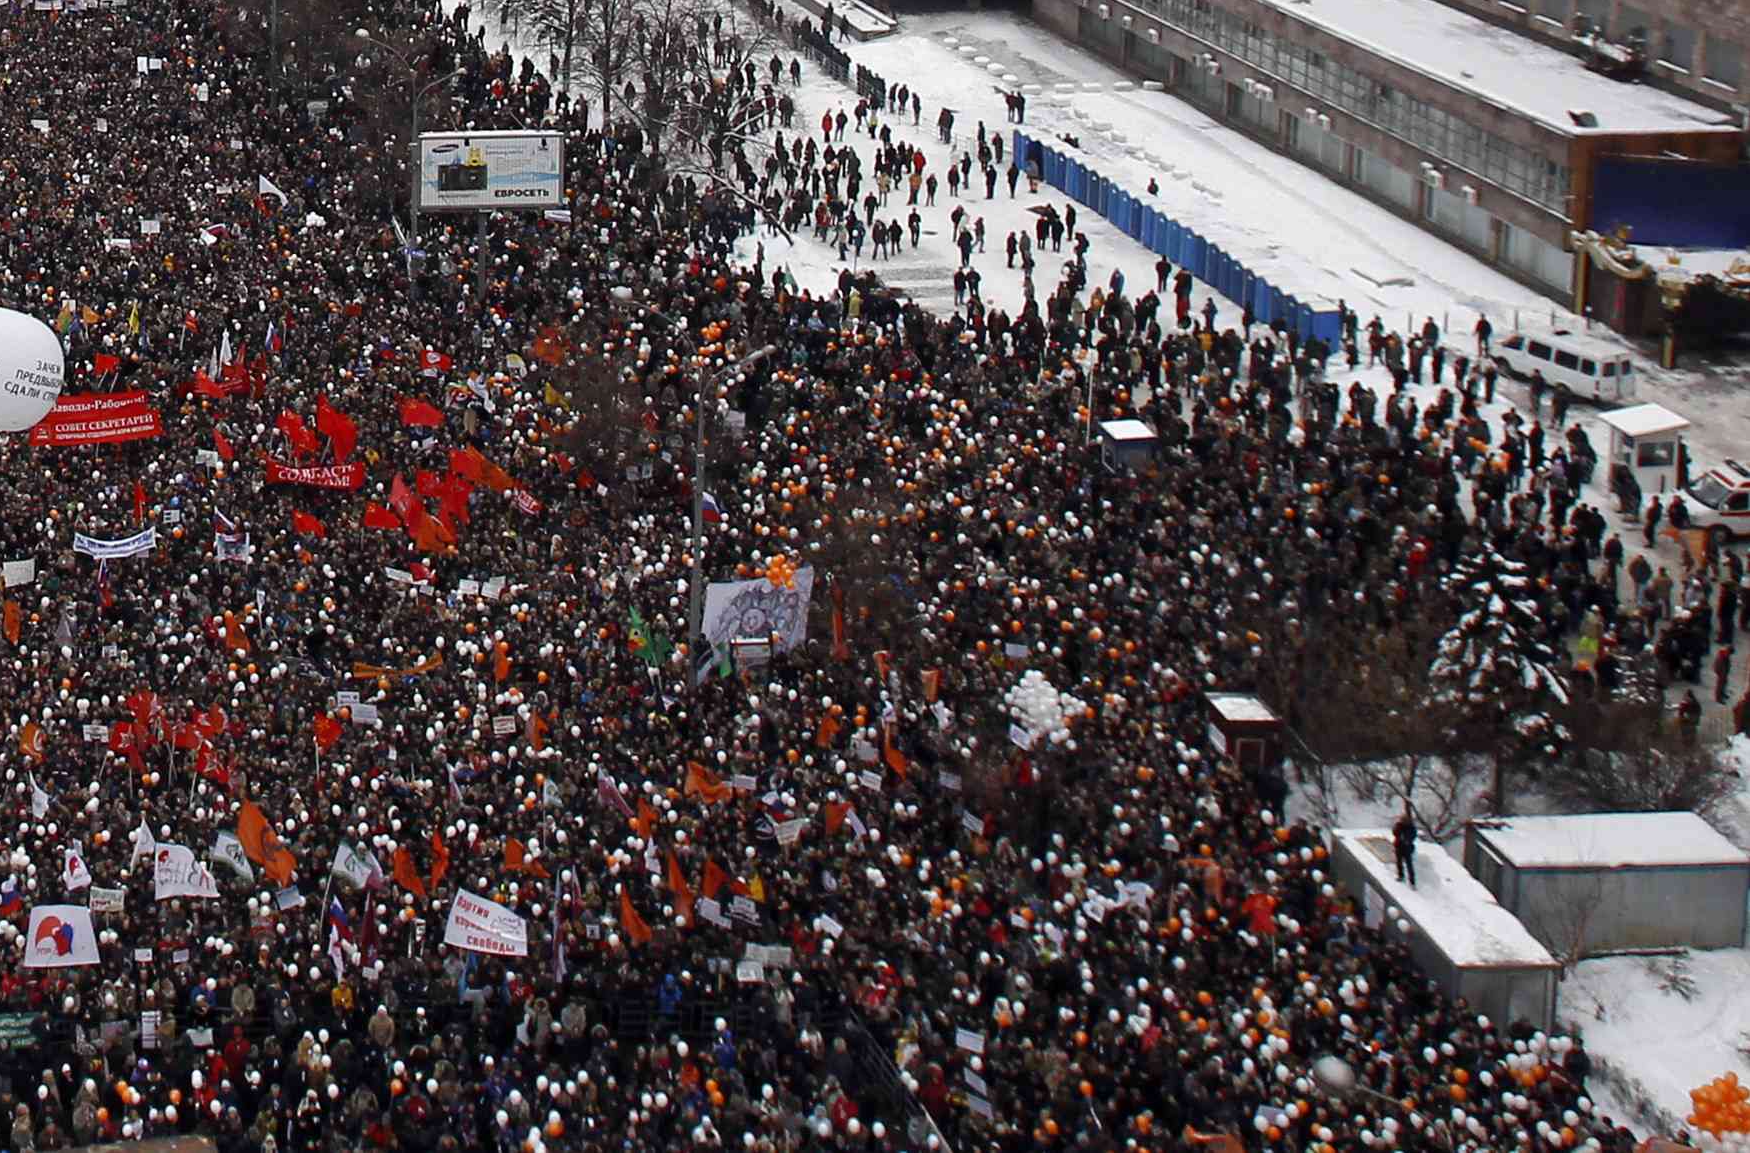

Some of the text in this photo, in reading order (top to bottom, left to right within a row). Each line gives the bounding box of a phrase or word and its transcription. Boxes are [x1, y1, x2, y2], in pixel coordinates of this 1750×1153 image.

[494, 189, 550, 198] ЕВРОСЕТЬ
[4, 381, 41, 399] СДАЛИ
[55, 422, 88, 432] СОВЕТ
